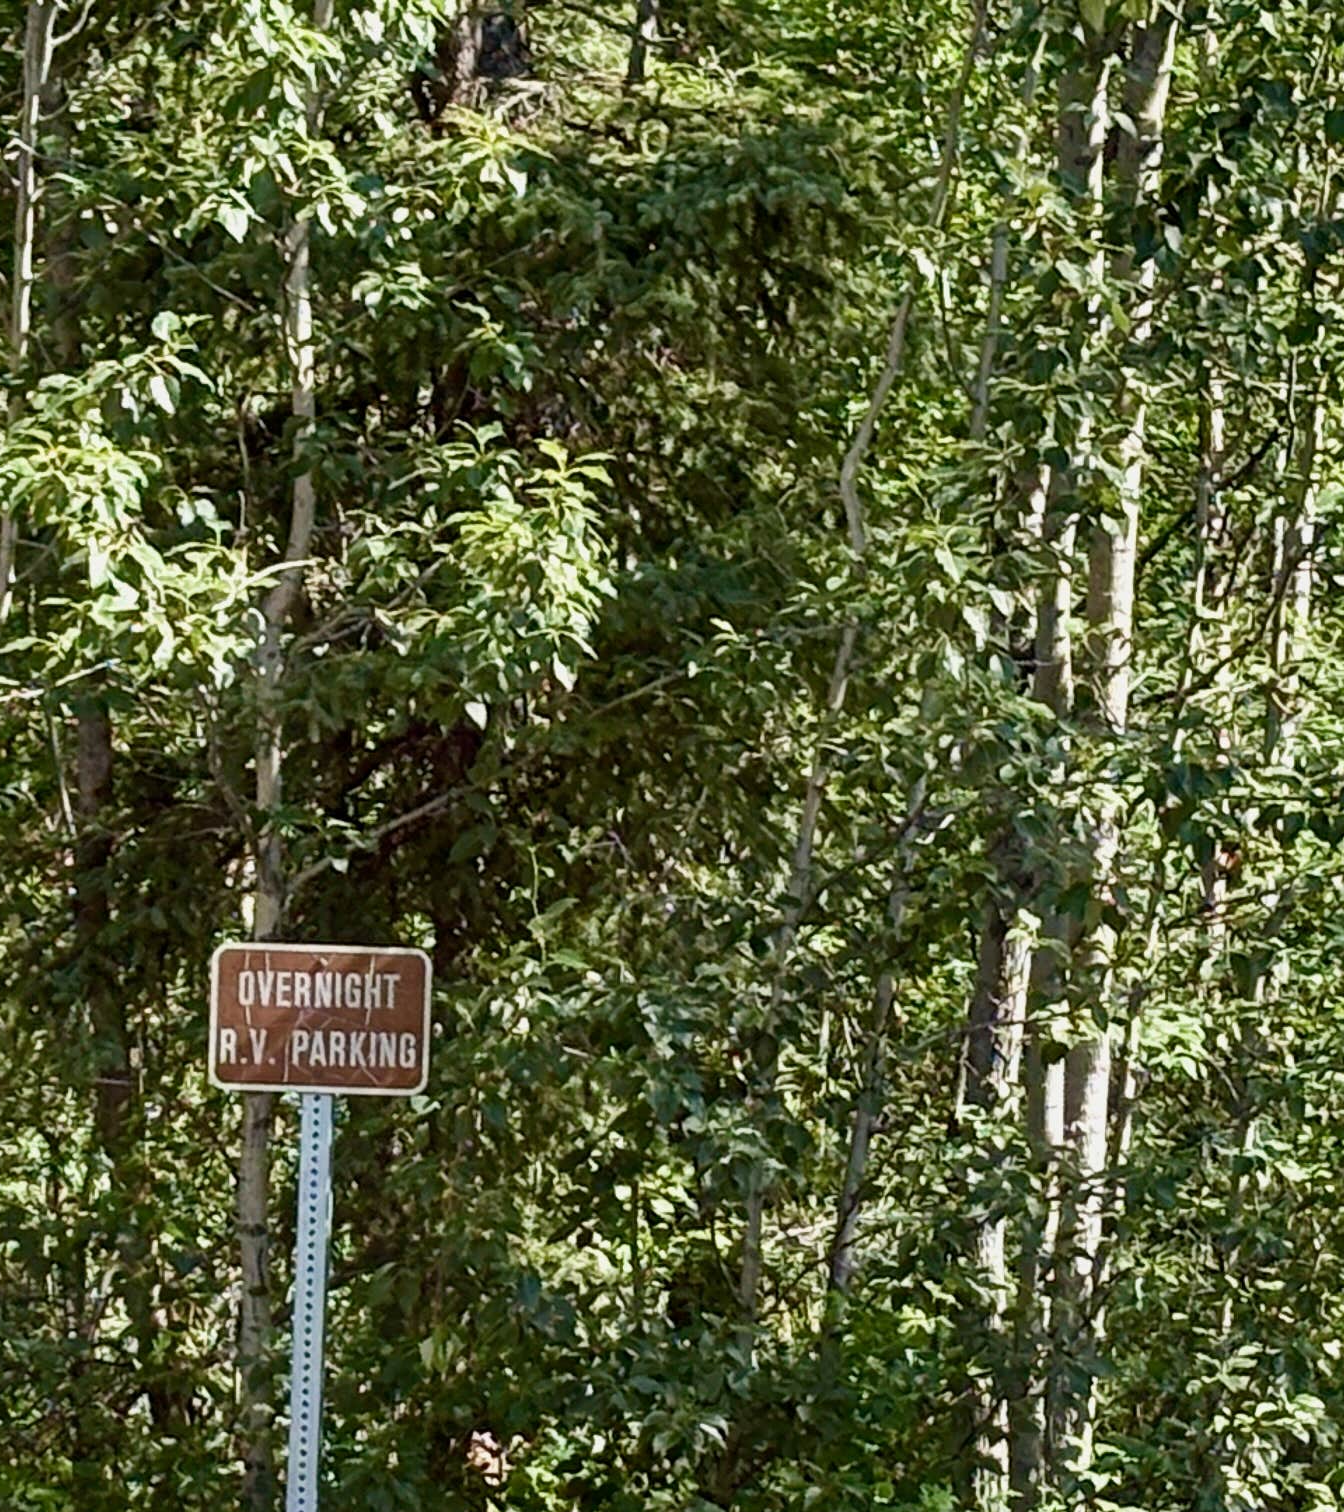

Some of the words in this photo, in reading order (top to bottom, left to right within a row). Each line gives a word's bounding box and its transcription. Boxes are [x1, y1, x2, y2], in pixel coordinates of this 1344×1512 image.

[238, 971, 401, 1009] OVERNIGHT
[219, 1028, 276, 1066] R.V.
[291, 1029, 417, 1069] PARKING
